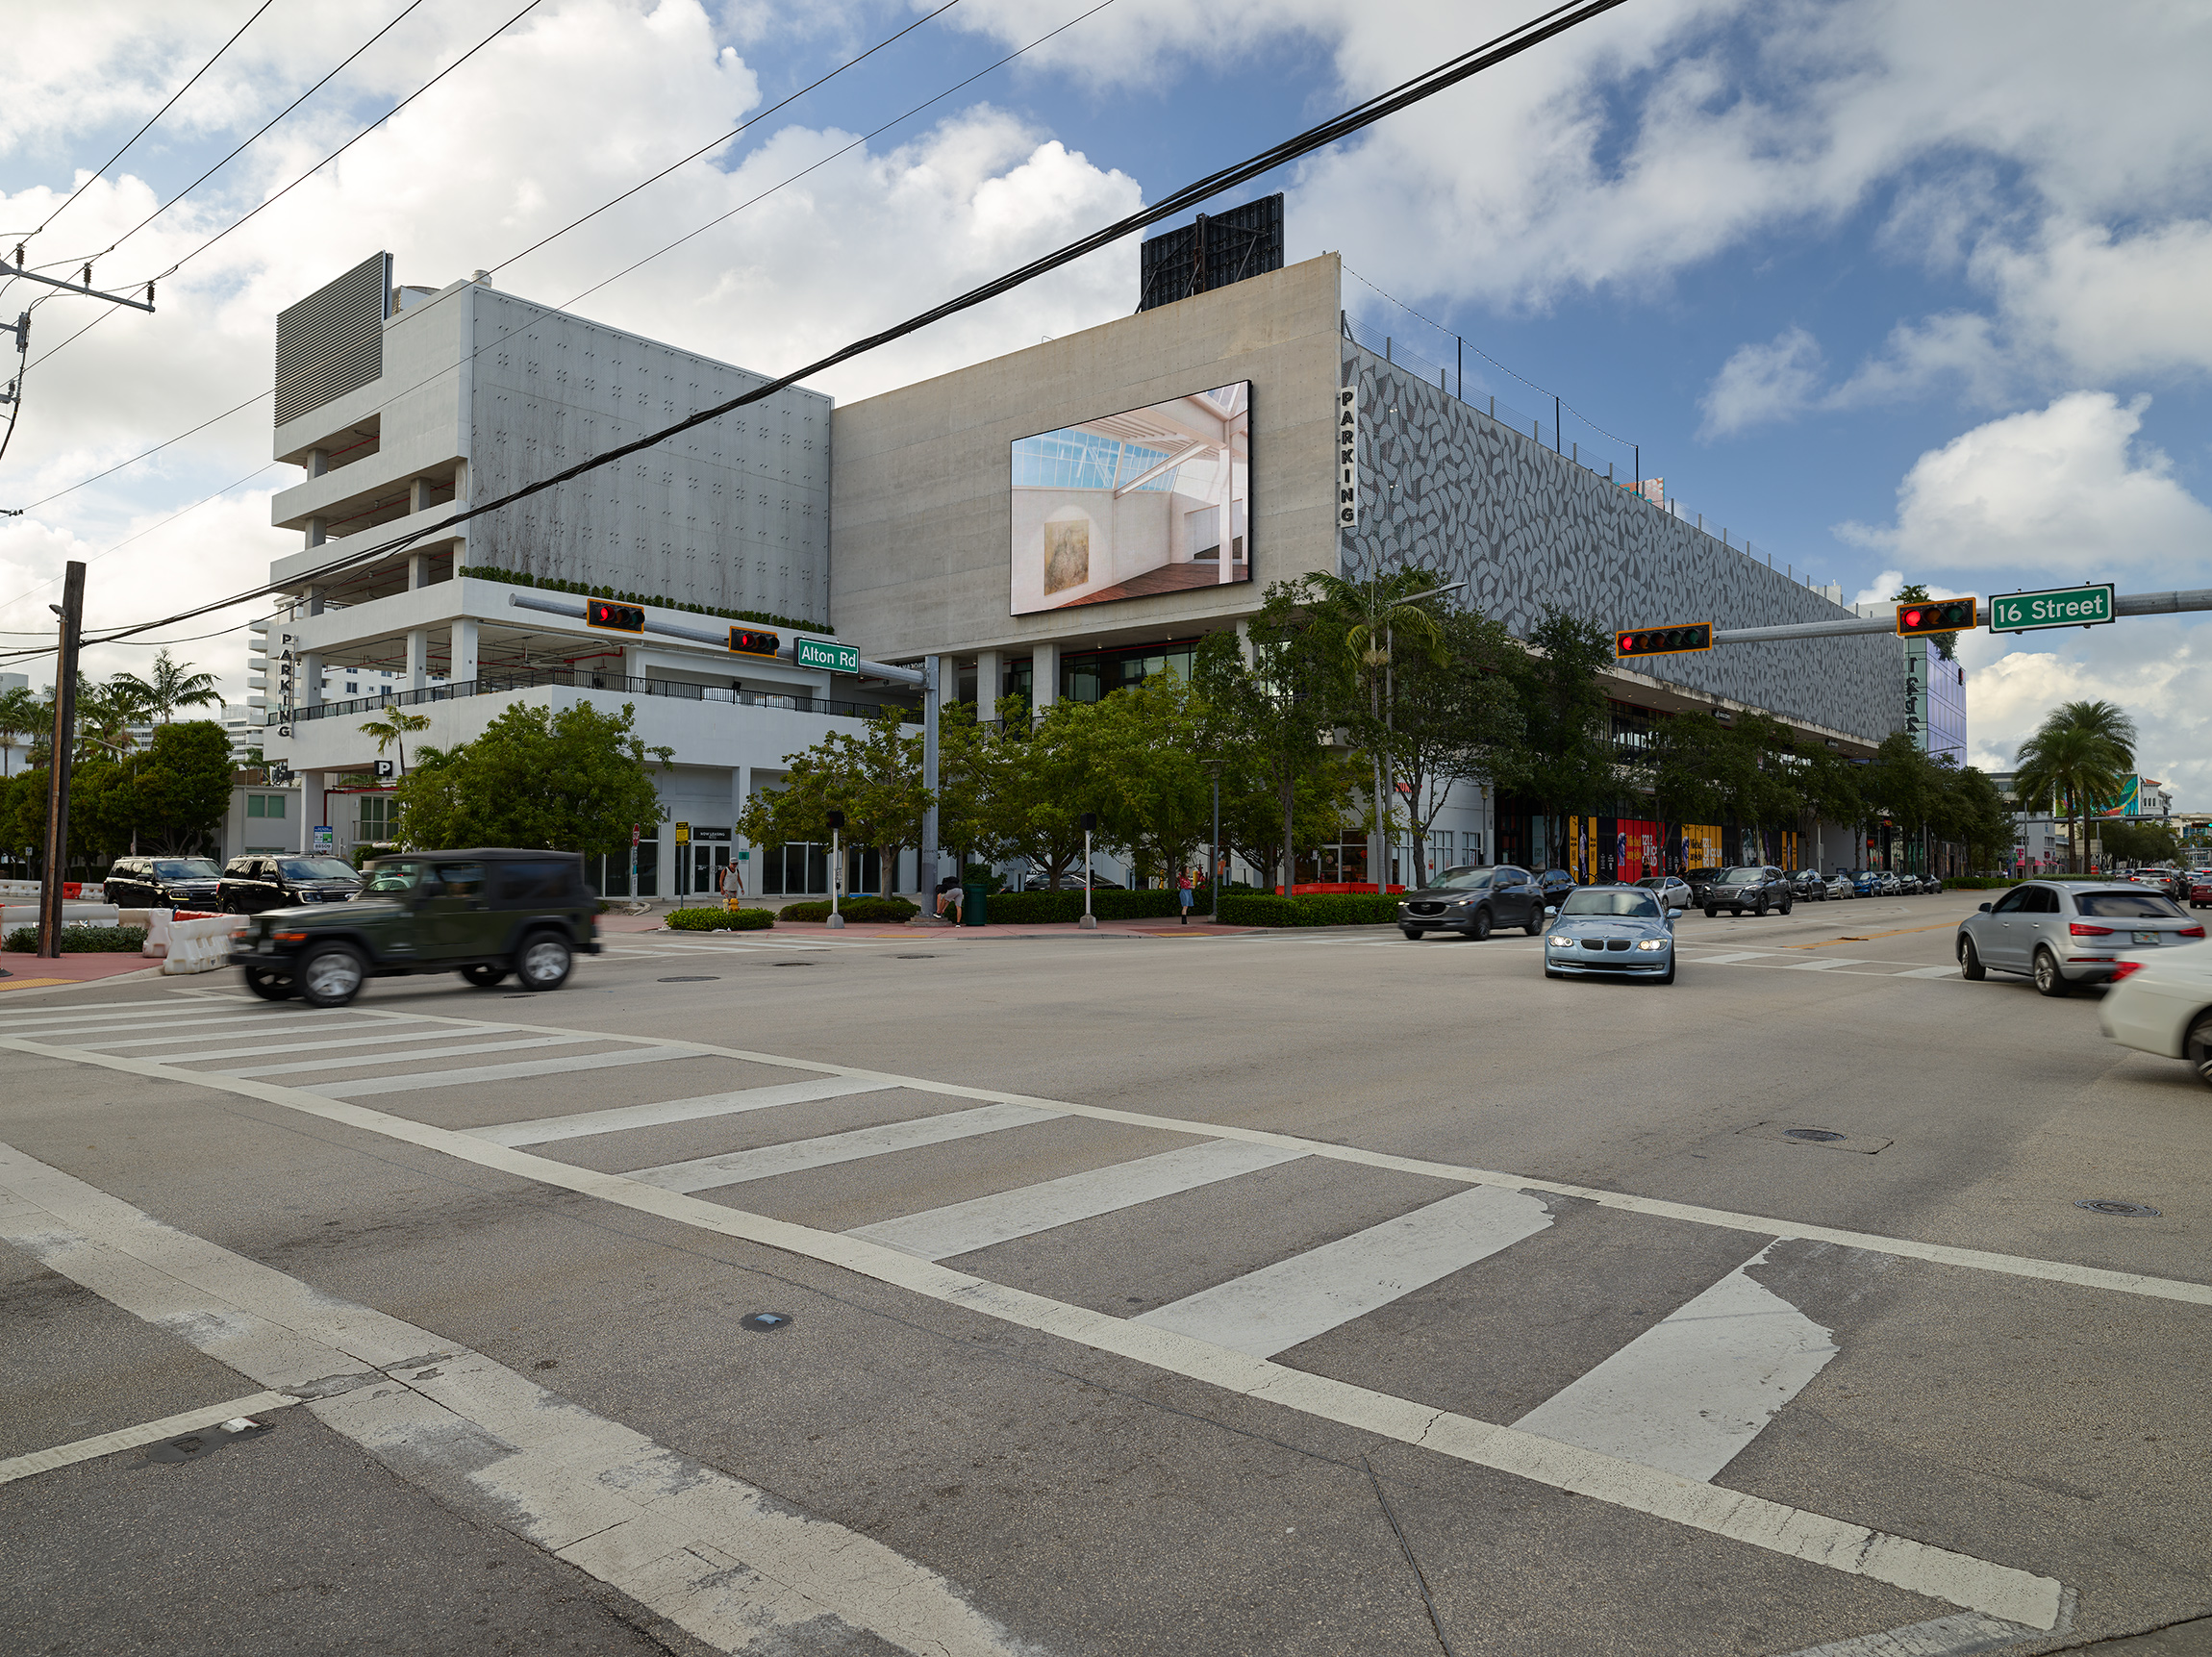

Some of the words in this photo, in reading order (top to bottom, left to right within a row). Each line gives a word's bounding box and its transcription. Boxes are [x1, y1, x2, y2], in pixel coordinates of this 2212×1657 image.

[1341, 390, 1354, 522] PARKING
[1998, 603, 2023, 623] 16
[2031, 594, 2103, 619] Street
[801, 645, 835, 665] Alton
[840, 651, 856, 667] Rd
[277, 633, 292, 738] PARKING
[378, 762, 390, 775] P
